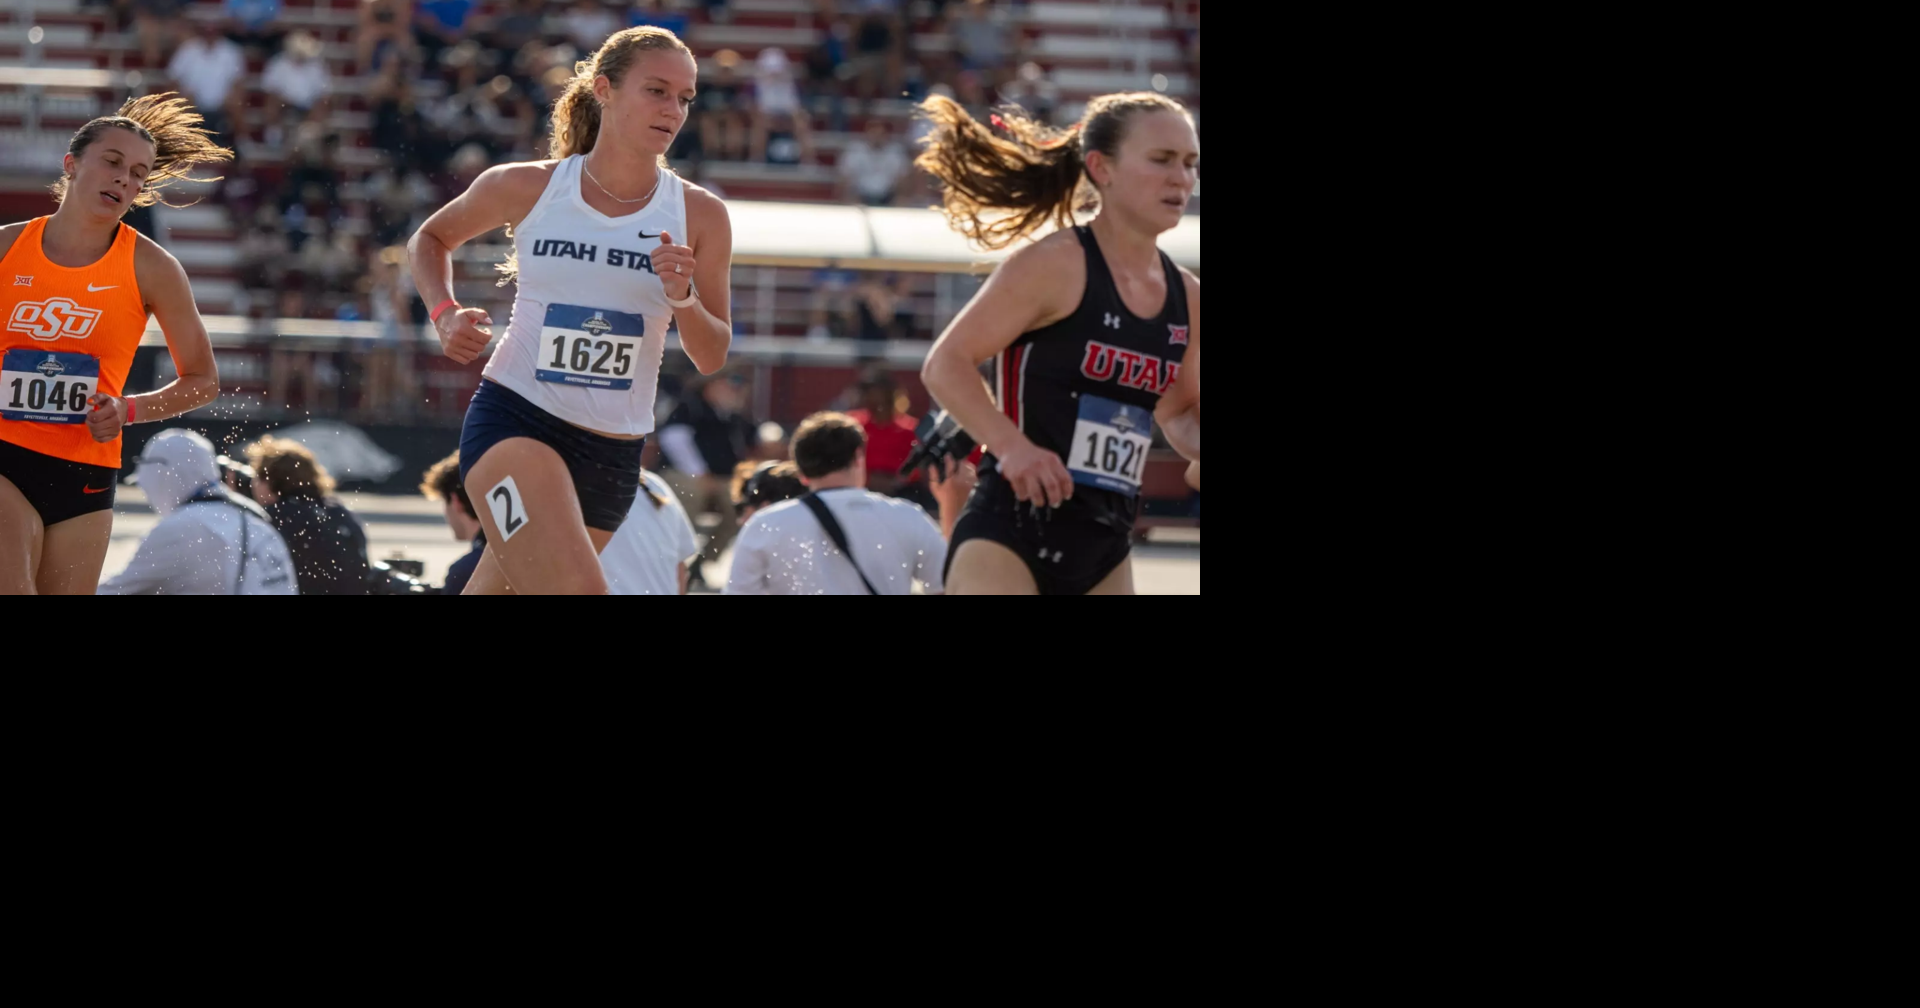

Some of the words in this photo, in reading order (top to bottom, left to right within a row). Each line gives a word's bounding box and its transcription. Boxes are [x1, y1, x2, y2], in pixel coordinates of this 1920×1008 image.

[532, 239, 597, 263] UTAH
[606, 248, 658, 276] STA
[7, 297, 103, 341] OSU
[550, 335, 634, 376] 1625
[8, 377, 88, 412] 1046
[1082, 431, 1144, 480] 1621
[492, 485, 523, 535] 2
